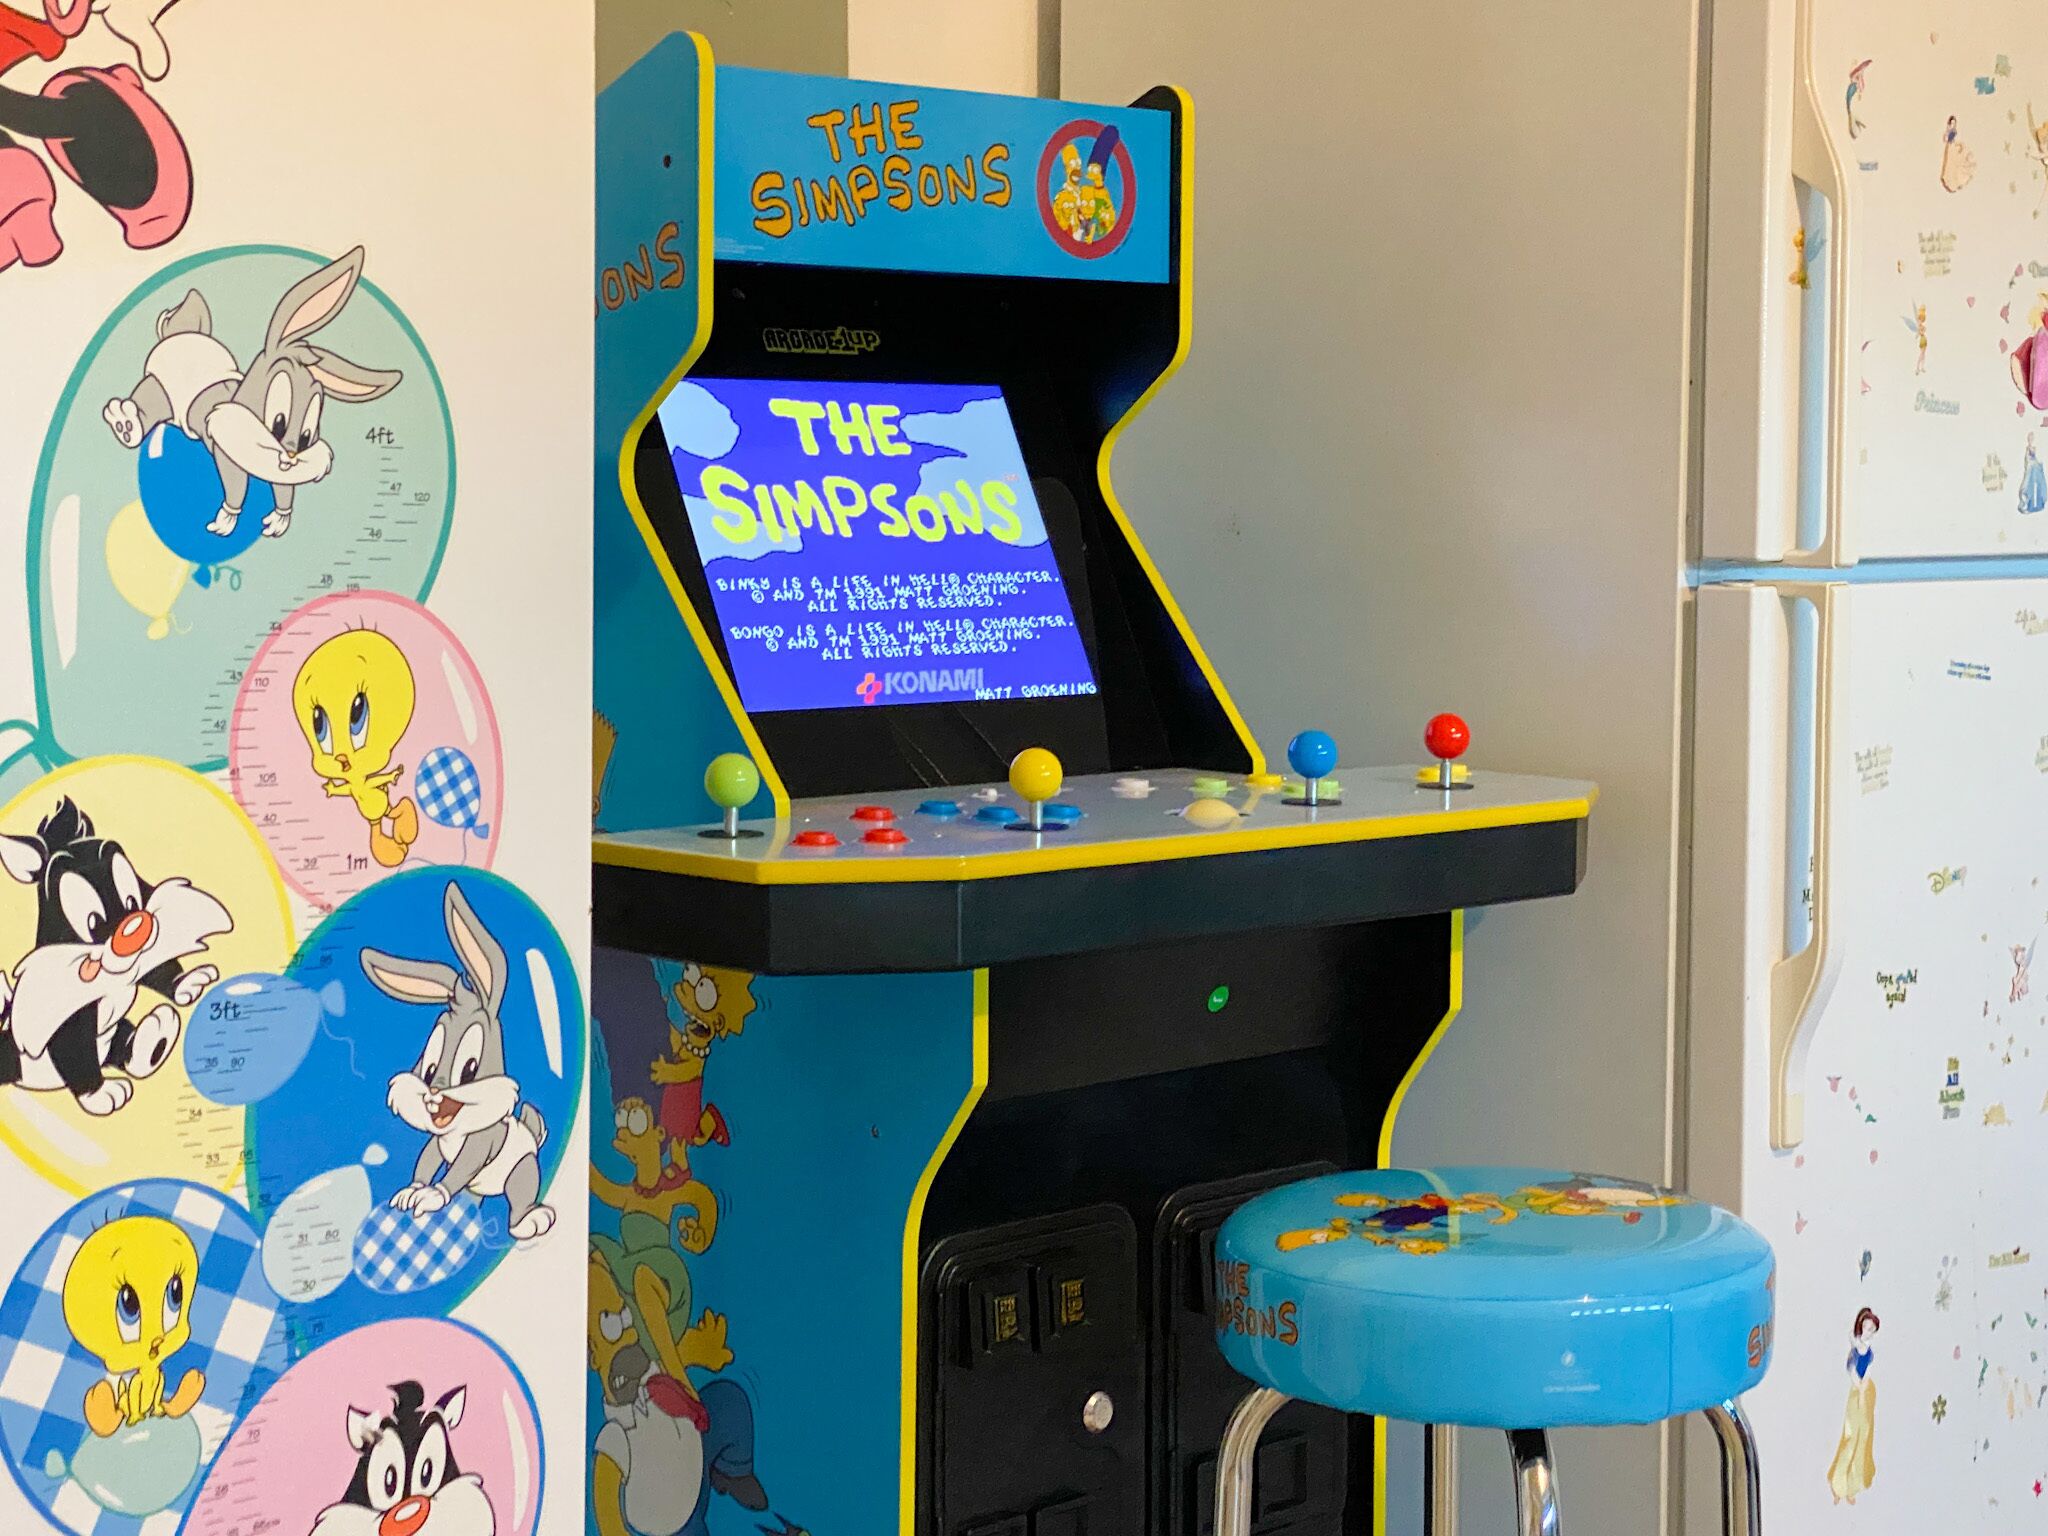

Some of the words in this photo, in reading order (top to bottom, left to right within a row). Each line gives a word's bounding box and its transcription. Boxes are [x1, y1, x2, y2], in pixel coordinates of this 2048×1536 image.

[807, 99, 923, 163] THE
[752, 143, 1011, 238] SIMPSONS
[365, 427, 394, 444] 4ft
[769, 398, 912, 456] THE
[700, 465, 1022, 543] SIMPSONS
[716, 577, 770, 591] BINKY
[783, 576, 801, 589] IS
[811, 576, 822, 588] A
[832, 575, 871, 588] LIFE
[884, 574, 900, 587] IN
[967, 570, 1060, 585] CHARACTER.
[773, 589, 804, 602] AND
[814, 588, 837, 600] TM
[843, 586, 885, 599] 1991
[894, 585, 932, 598] MATT
[942, 583, 1026, 597] GROENING.
[807, 600, 838, 612] ALL
[847, 597, 908, 611] RIGHTS
[916, 595, 1002, 609] RESERVED.
[730, 625, 784, 639] BONGO
[797, 624, 816, 637] IS
[825, 624, 836, 636] A
[847, 622, 886, 636] LIFE
[897, 621, 914, 633] IN
[981, 615, 1074, 630] CHARACTER.
[787, 636, 818, 650] AND
[829, 635, 851, 648] TM
[858, 634, 900, 647] 1991
[908, 631, 947, 644] MATT
[956, 629, 1040, 643] GROENING.
[821, 647, 852, 660] ALL
[861, 645, 922, 658] RIGHTS
[931, 641, 1016, 656] RESERVED.
[254, 677, 269, 687] 110
[884, 668, 984, 695] KONAMI
[975, 686, 1013, 700] MATT
[1021, 682, 1097, 698] GROENING
[213, 720, 226, 730] 42
[259, 773, 277, 783] 105
[263, 814, 277, 824] 40
[303, 857, 317, 868] 39
[346, 854, 368, 870] 1m
[210, 1001, 241, 1020] 3ft
[302, 1280, 316, 1291] 30
